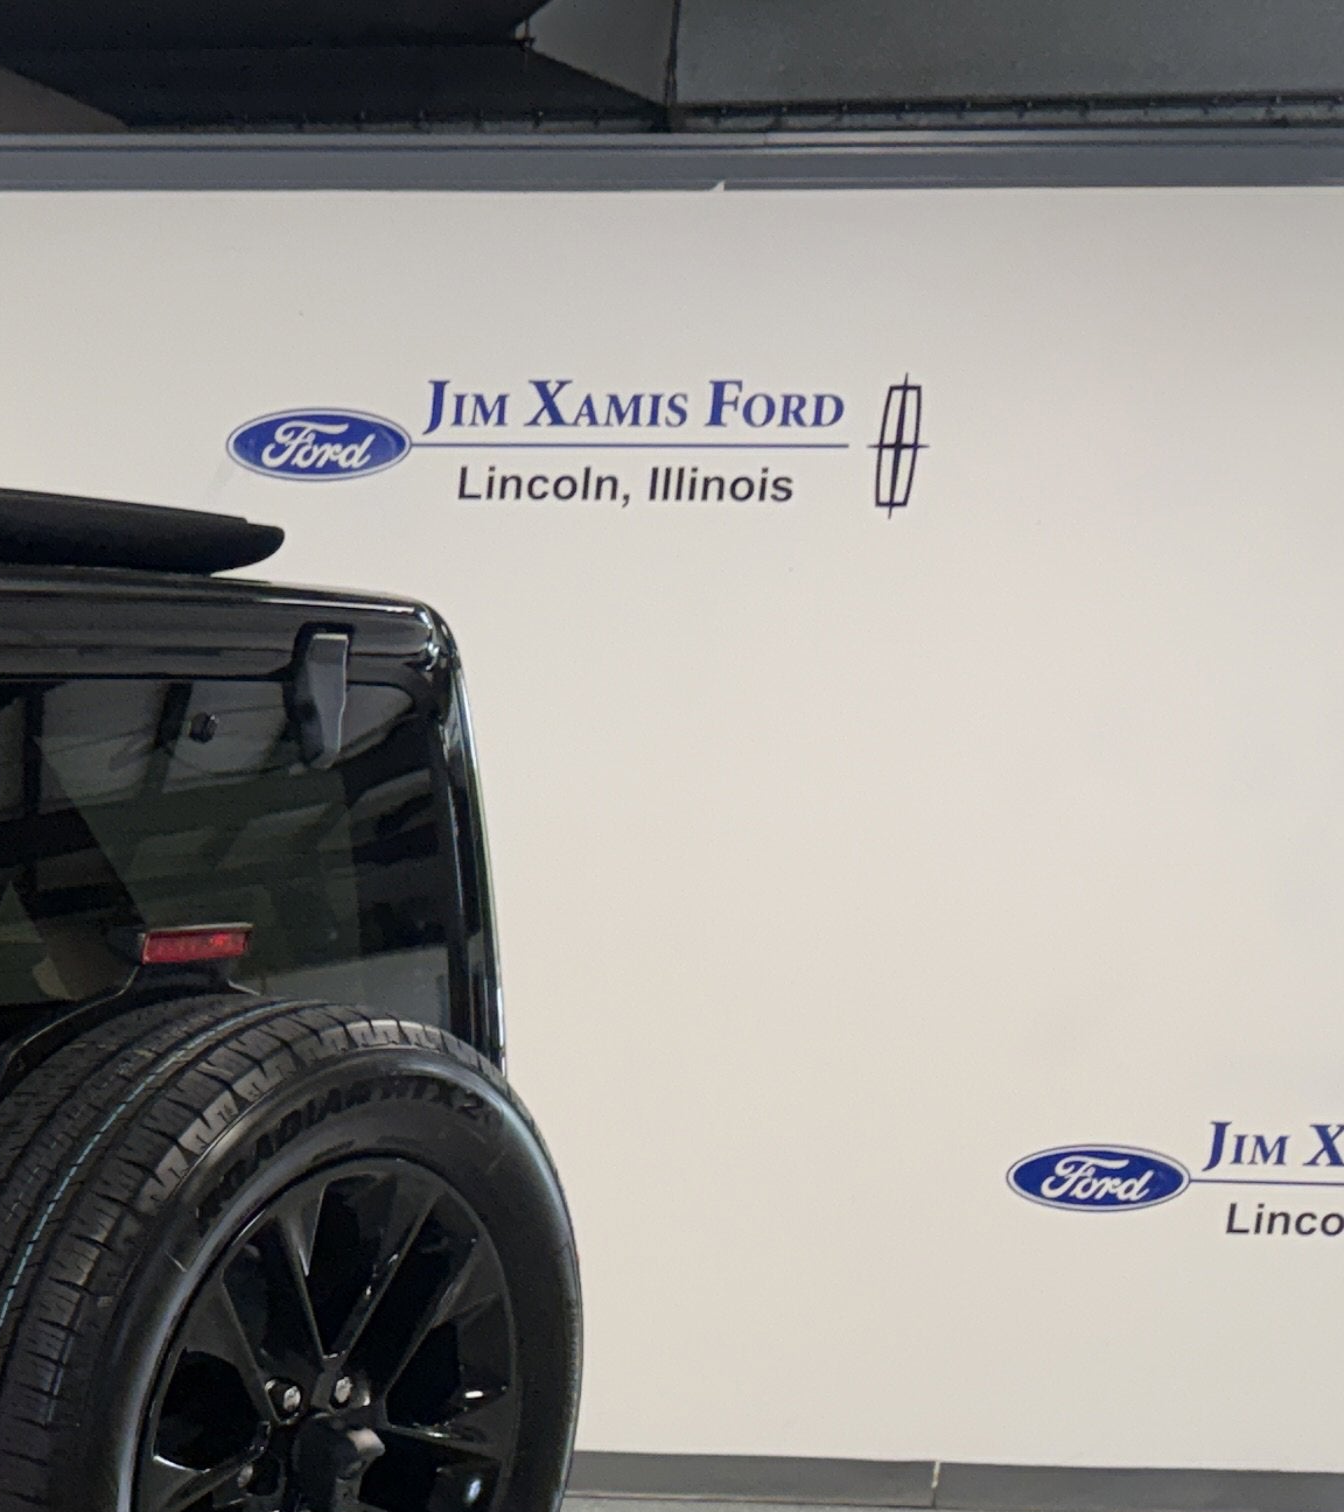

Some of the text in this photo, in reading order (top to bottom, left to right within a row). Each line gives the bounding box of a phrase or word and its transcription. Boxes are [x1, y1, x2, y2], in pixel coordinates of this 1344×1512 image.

[422, 378, 846, 435] JIM XAMIS FORD
[261, 420, 372, 470] Ford
[456, 465, 795, 508] Lincoln, Illinois
[1201, 1120, 1291, 1172] JIM
[1040, 1155, 1155, 1202] Ford
